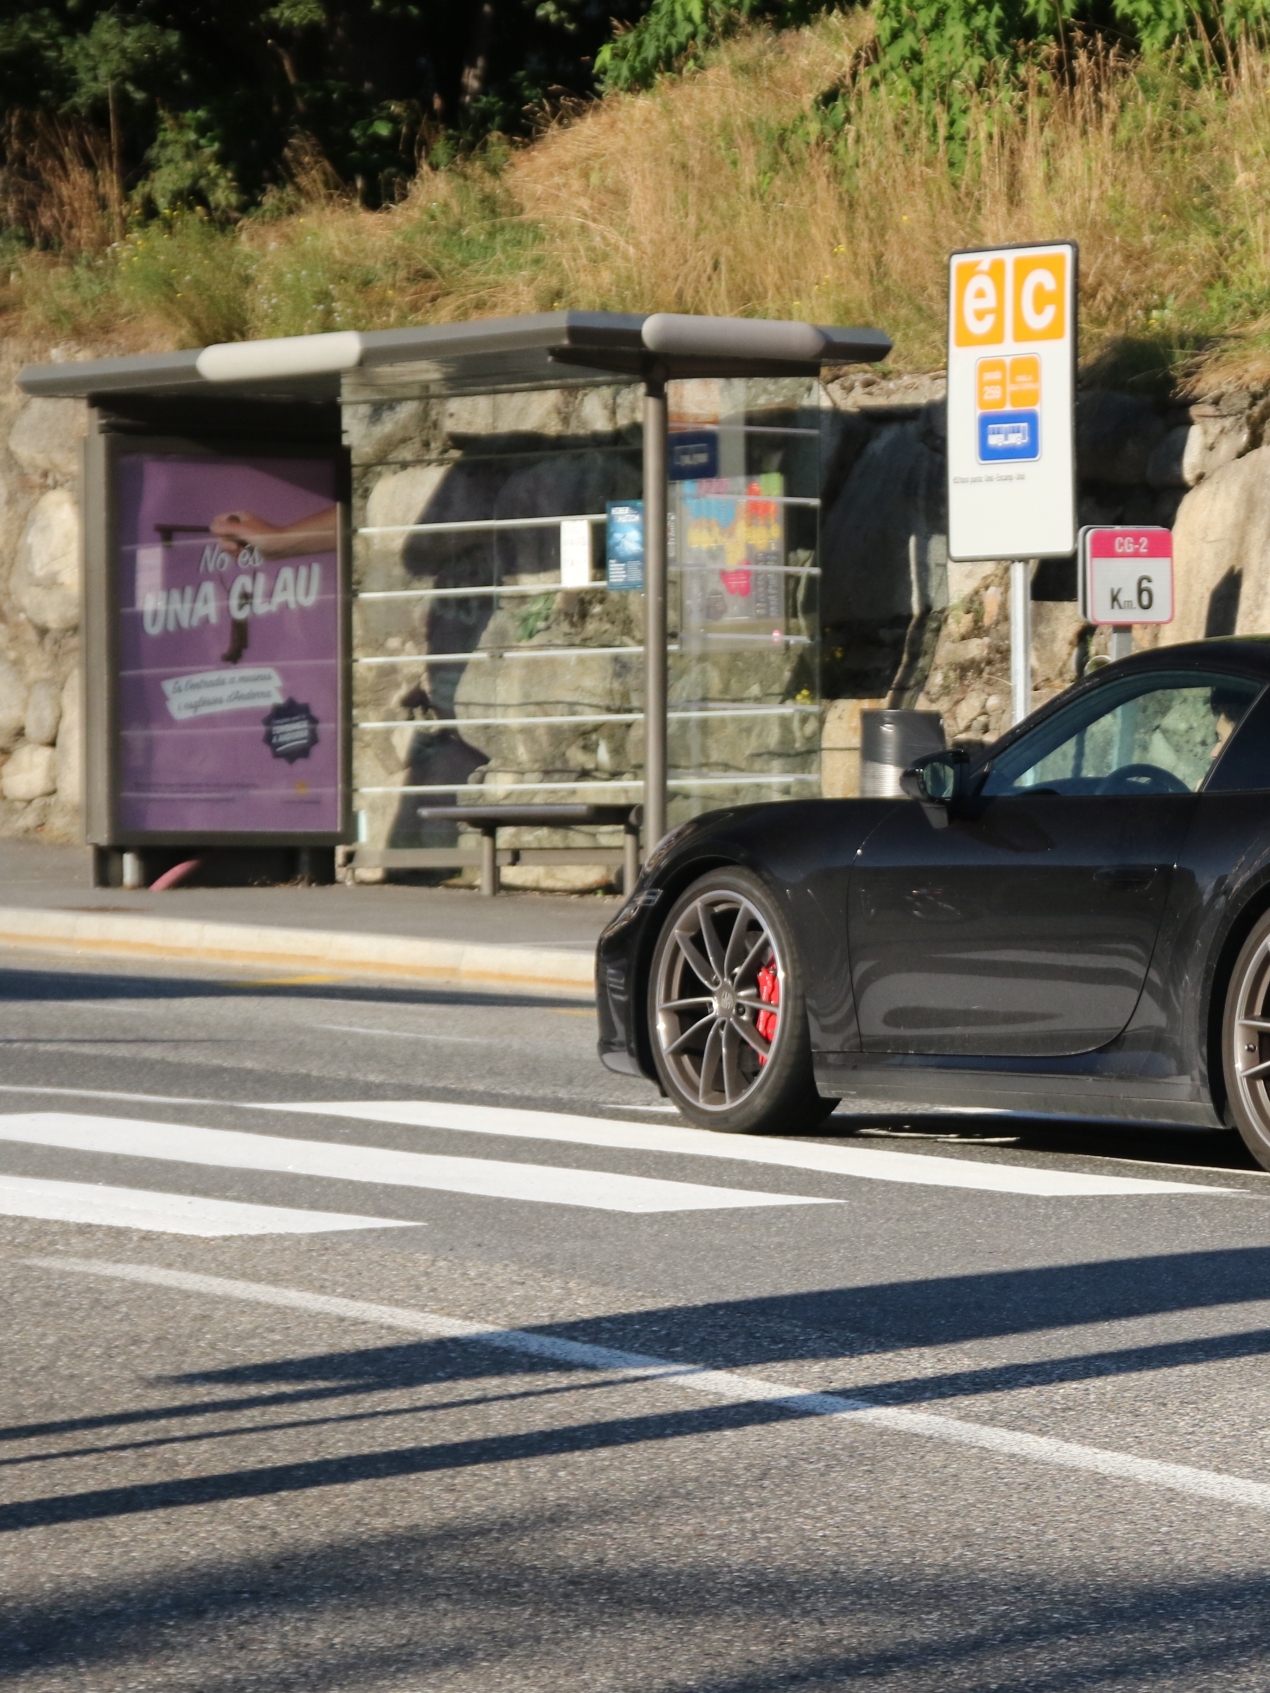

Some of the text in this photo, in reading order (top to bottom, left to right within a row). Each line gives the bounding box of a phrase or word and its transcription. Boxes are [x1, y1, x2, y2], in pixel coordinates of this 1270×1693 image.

[200, 543, 265, 573] No és
[1114, 536, 1149, 553] CG-2
[142, 562, 321, 635] UNA CLAU
